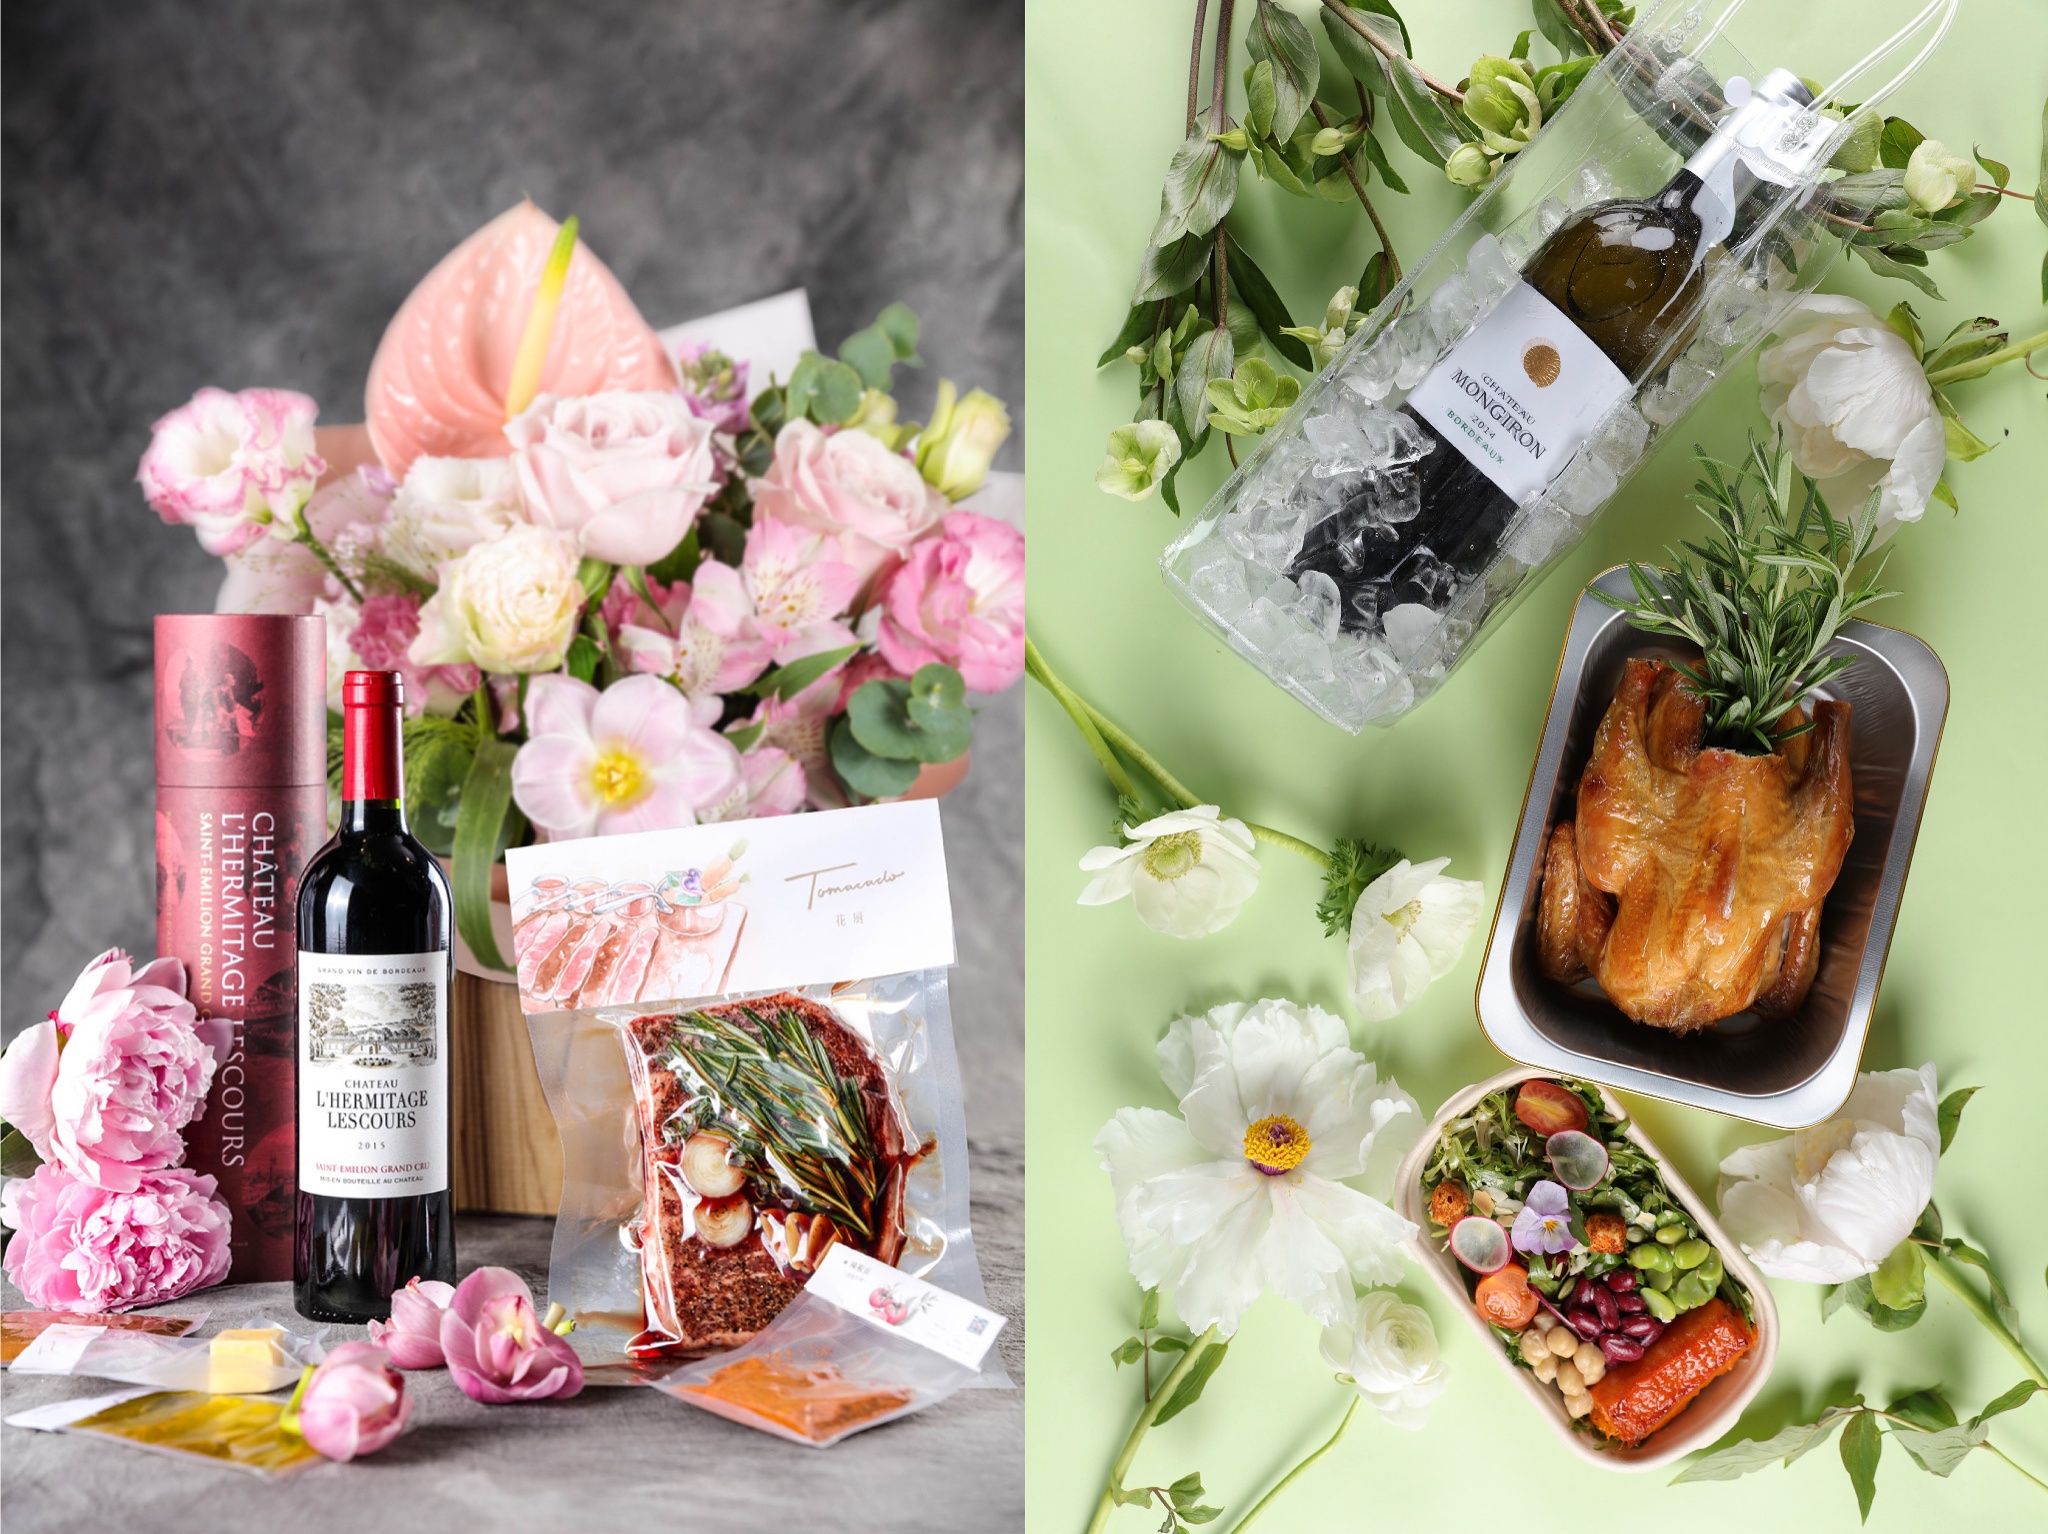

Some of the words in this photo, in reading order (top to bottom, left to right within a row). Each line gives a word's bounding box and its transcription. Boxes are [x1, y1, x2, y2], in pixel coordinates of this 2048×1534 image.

[1481, 373, 1536, 426] CHATEAU
[1451, 367, 1547, 460] MONGIRON
[1446, 408, 1505, 466] BORDEAUX
[1470, 413, 1497, 440] 2014
[200, 812, 213, 938] SAINT-EMILION
[221, 813, 246, 1008] L'HERMITAGE
[200, 942, 213, 1004] GRAND
[317, 967, 344, 975] GRAND
[382, 967, 426, 975] BORDEAUX
[344, 1079, 399, 1089] CHATEAU
[316, 1090, 429, 1110] L'HERMITAGE
[327, 1111, 417, 1130] LESCOURS
[358, 1141, 386, 1150] 2015
[380, 1163, 413, 1174] GRAND
[413, 1162, 430, 1171] CRU
[393, 1175, 424, 1184] CHATEAU
